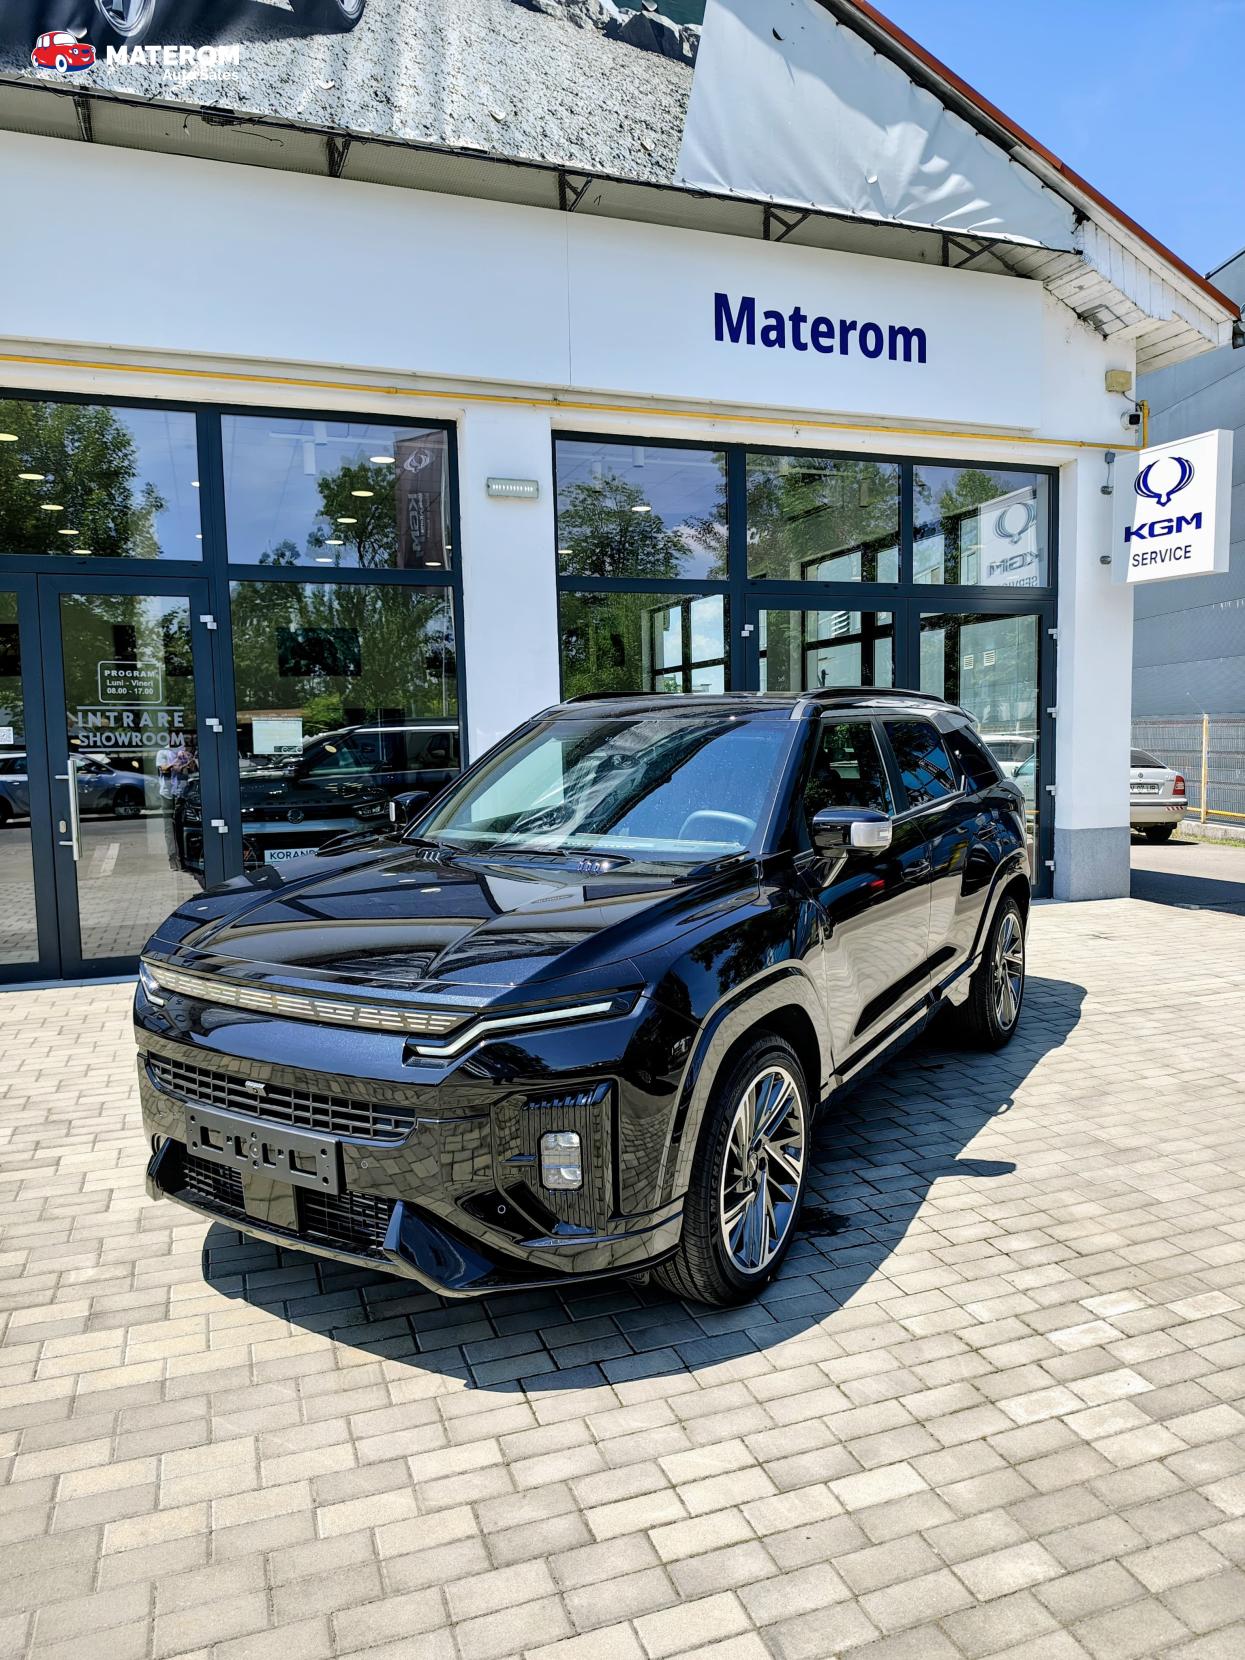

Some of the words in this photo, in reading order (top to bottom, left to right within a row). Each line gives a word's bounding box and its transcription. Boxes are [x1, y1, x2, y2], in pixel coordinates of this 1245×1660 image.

[714, 292, 927, 364] Materom
[1124, 511, 1203, 543] KGM
[1132, 544, 1192, 568] SERVICE
[104, 669, 156, 678] PROGRAM
[106, 679, 124, 687] Luni
[106, 687, 127, 695] 08.00
[134, 687, 154, 695] 17.00
[77, 711, 184, 727] INTRARE
[79, 732, 185, 746] SHOWROOM
